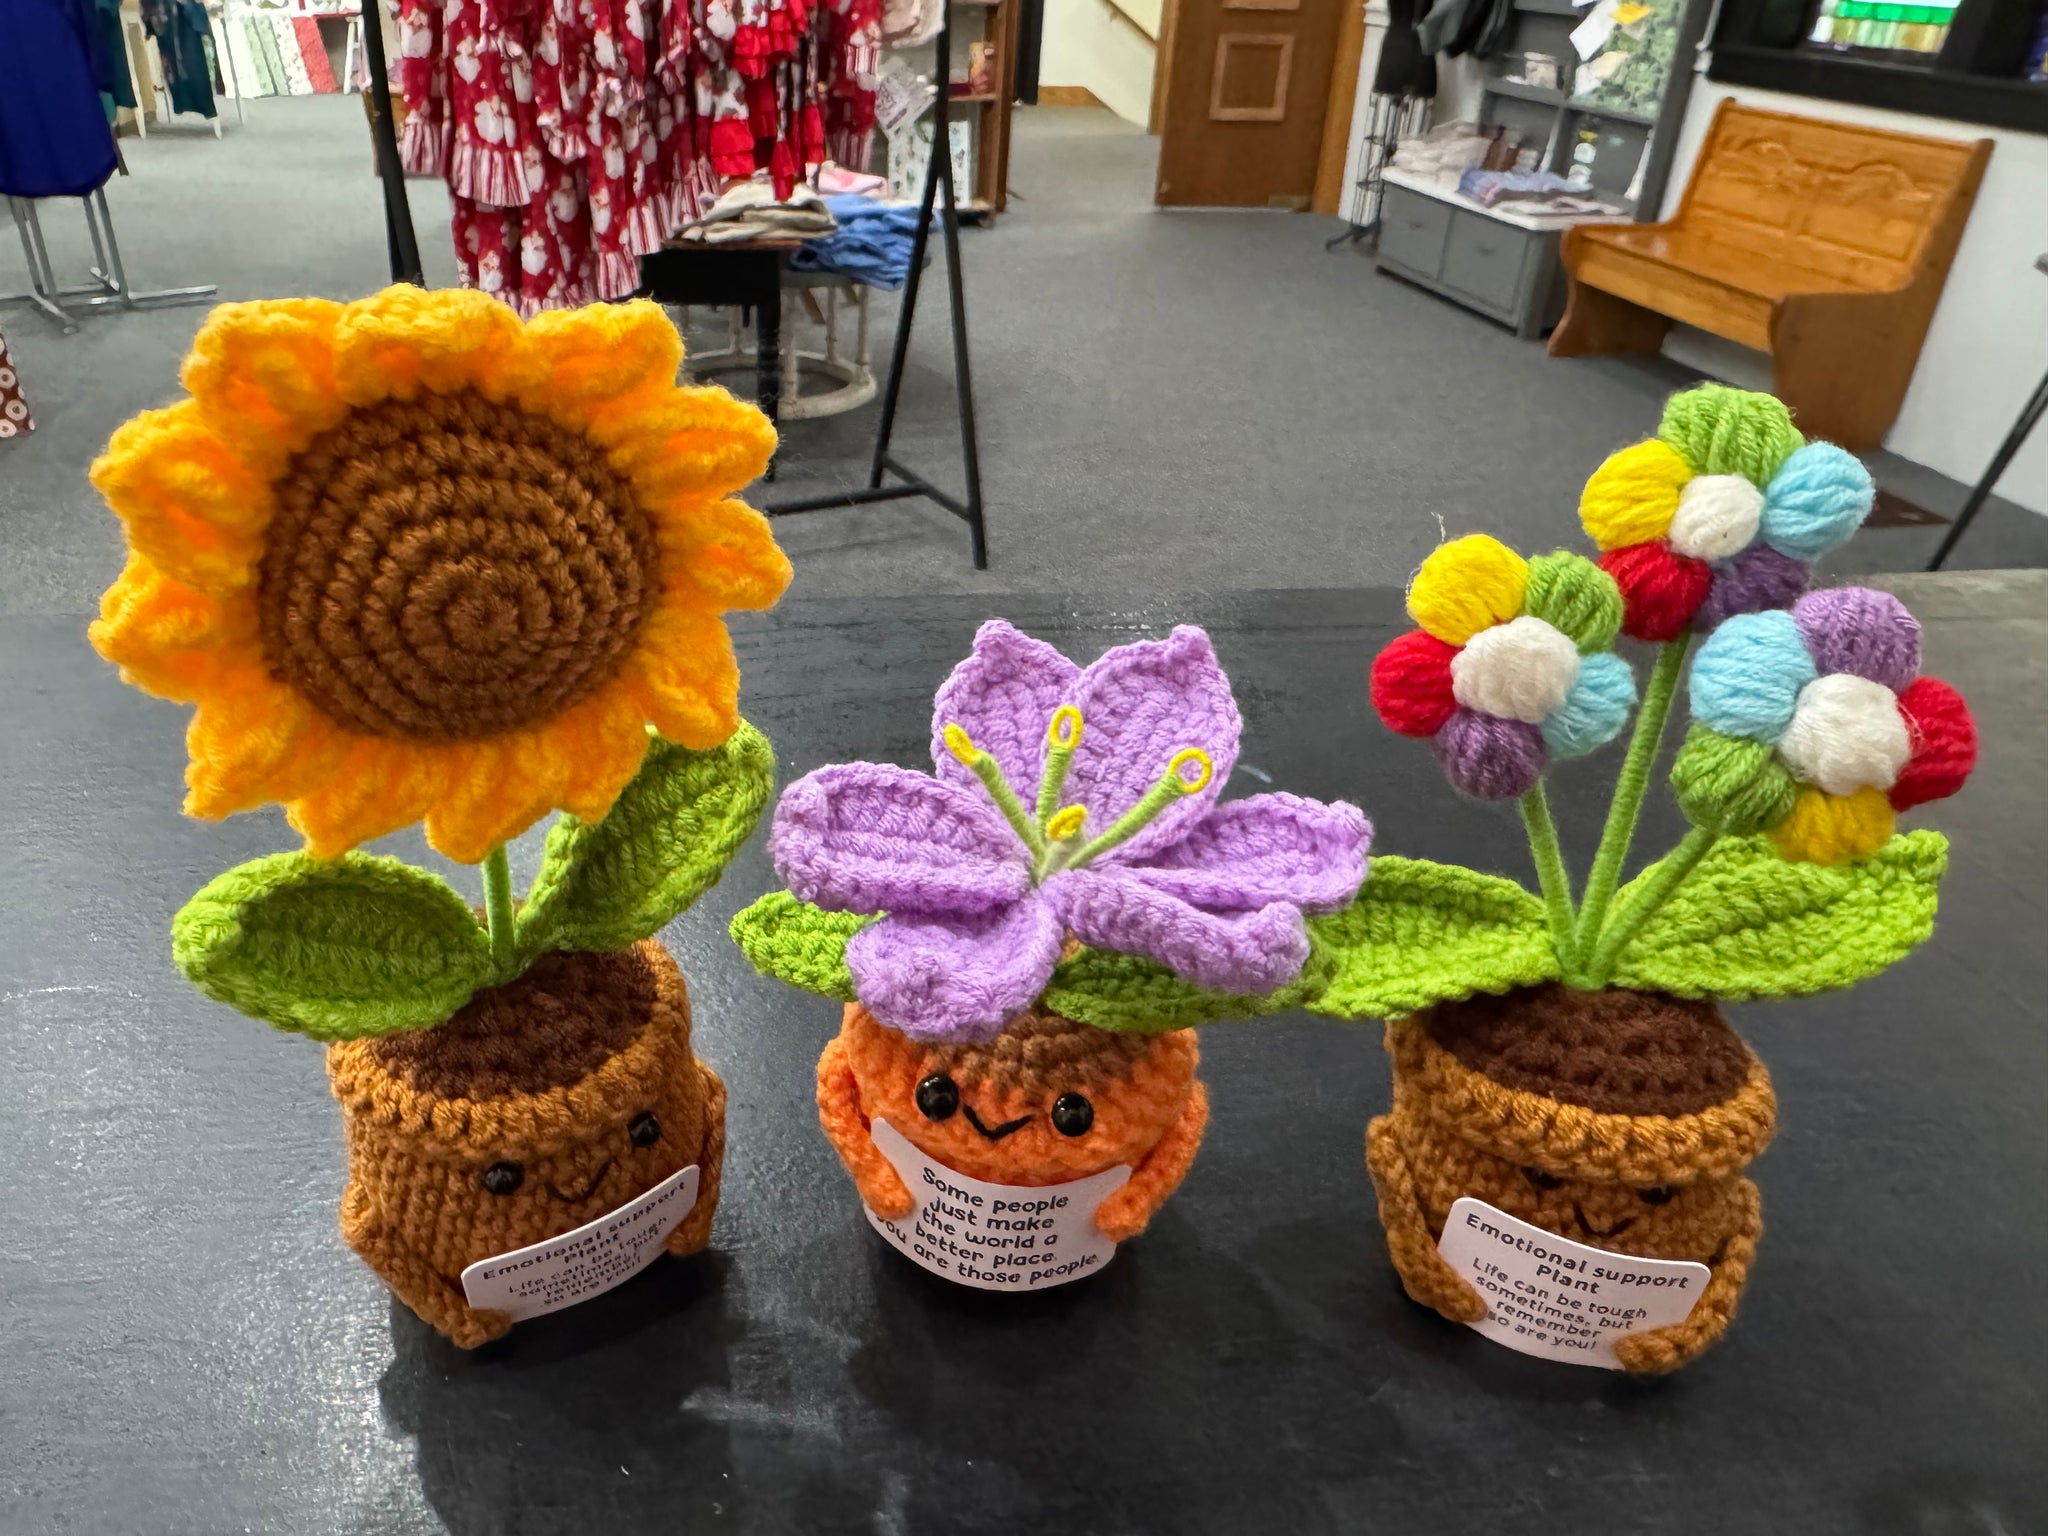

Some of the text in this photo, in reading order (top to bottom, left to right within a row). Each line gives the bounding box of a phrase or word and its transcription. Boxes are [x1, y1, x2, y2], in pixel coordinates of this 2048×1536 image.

[922, 1166, 1069, 1215] Some people
[483, 1182, 686, 1280] Emotional support
[922, 1207, 1058, 1249] the world a
[930, 1196, 1055, 1232] just make
[915, 1221, 984, 1262] better
[1465, 1212, 1690, 1289] Emotional support
[913, 1242, 949, 1269] are
[957, 1263, 1021, 1284] those
[1535, 1263, 1601, 1295] Plant
[1472, 1257, 1648, 1320] Life can be tough
[1496, 1300, 1603, 1339] remember
[1514, 1321, 1548, 1342] are
[1598, 1316, 1634, 1330] but
